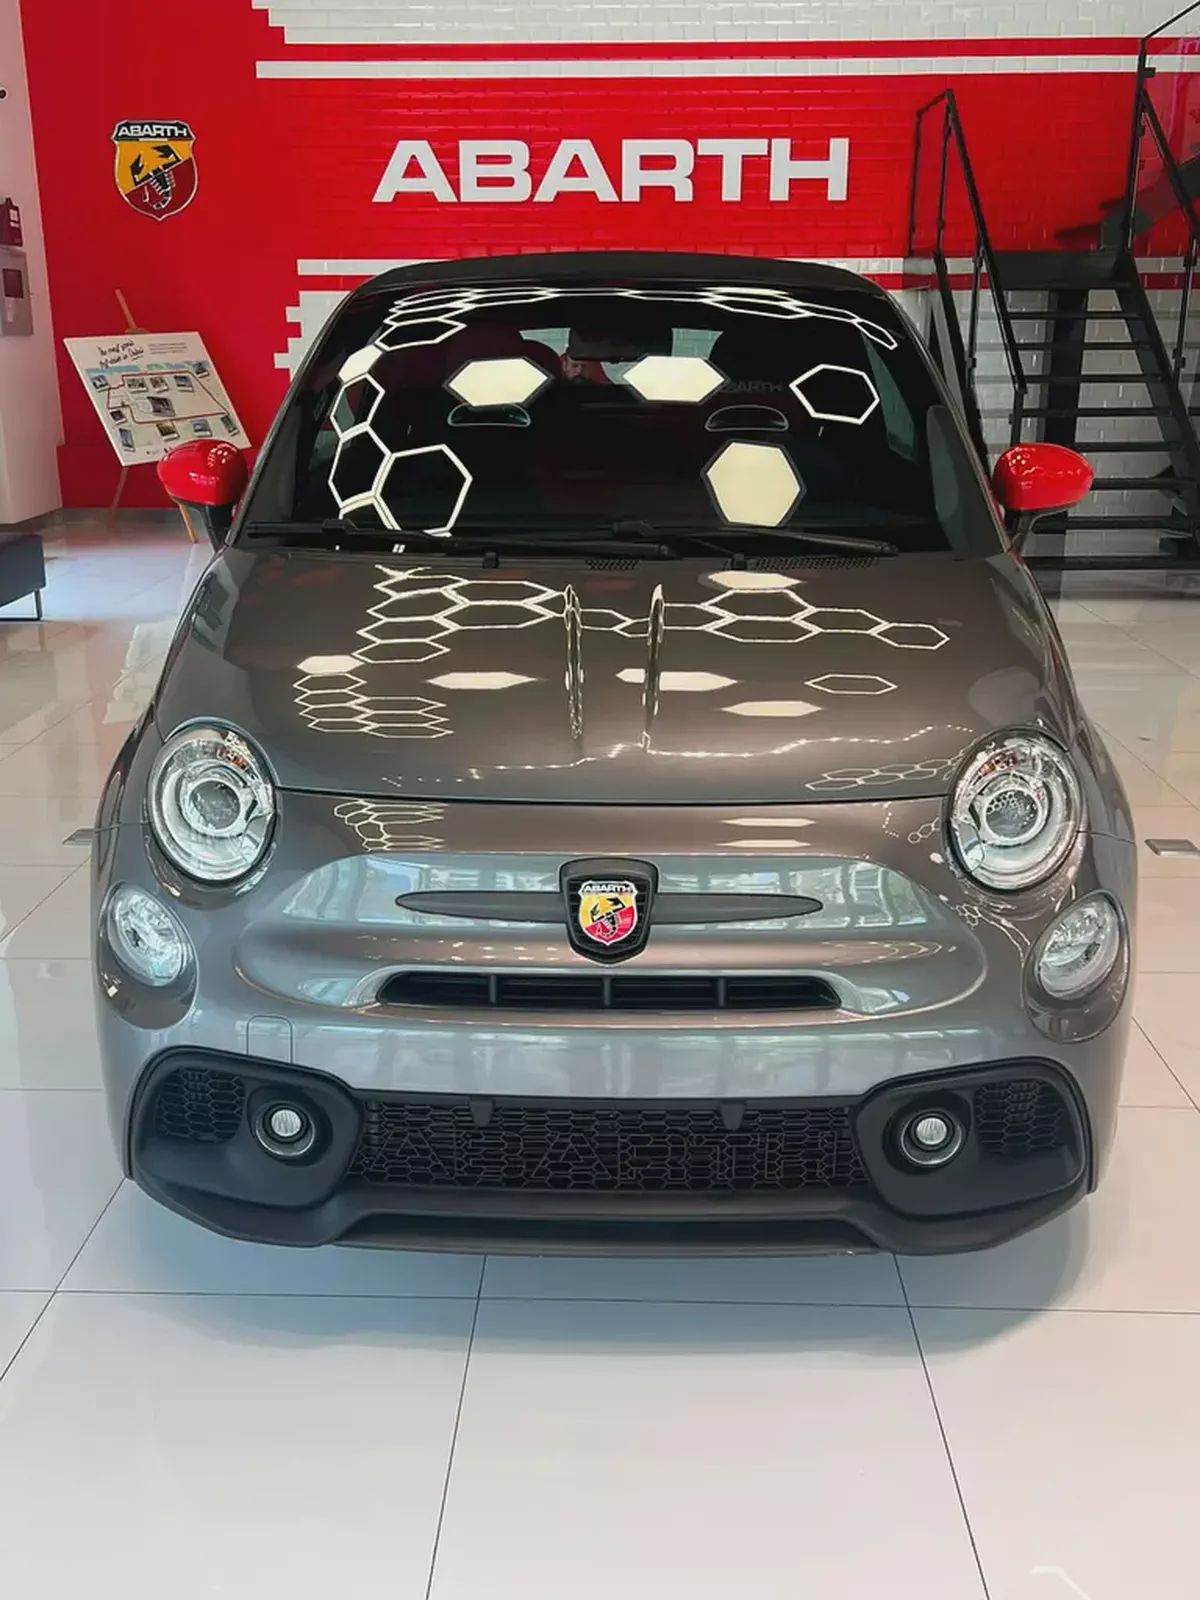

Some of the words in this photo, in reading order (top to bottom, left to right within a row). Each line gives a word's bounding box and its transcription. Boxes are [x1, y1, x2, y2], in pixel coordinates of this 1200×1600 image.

[118, 124, 188, 137] ABARTH
[372, 138, 850, 202] ABARTH
[372, 1127, 837, 1181] ABARTH
